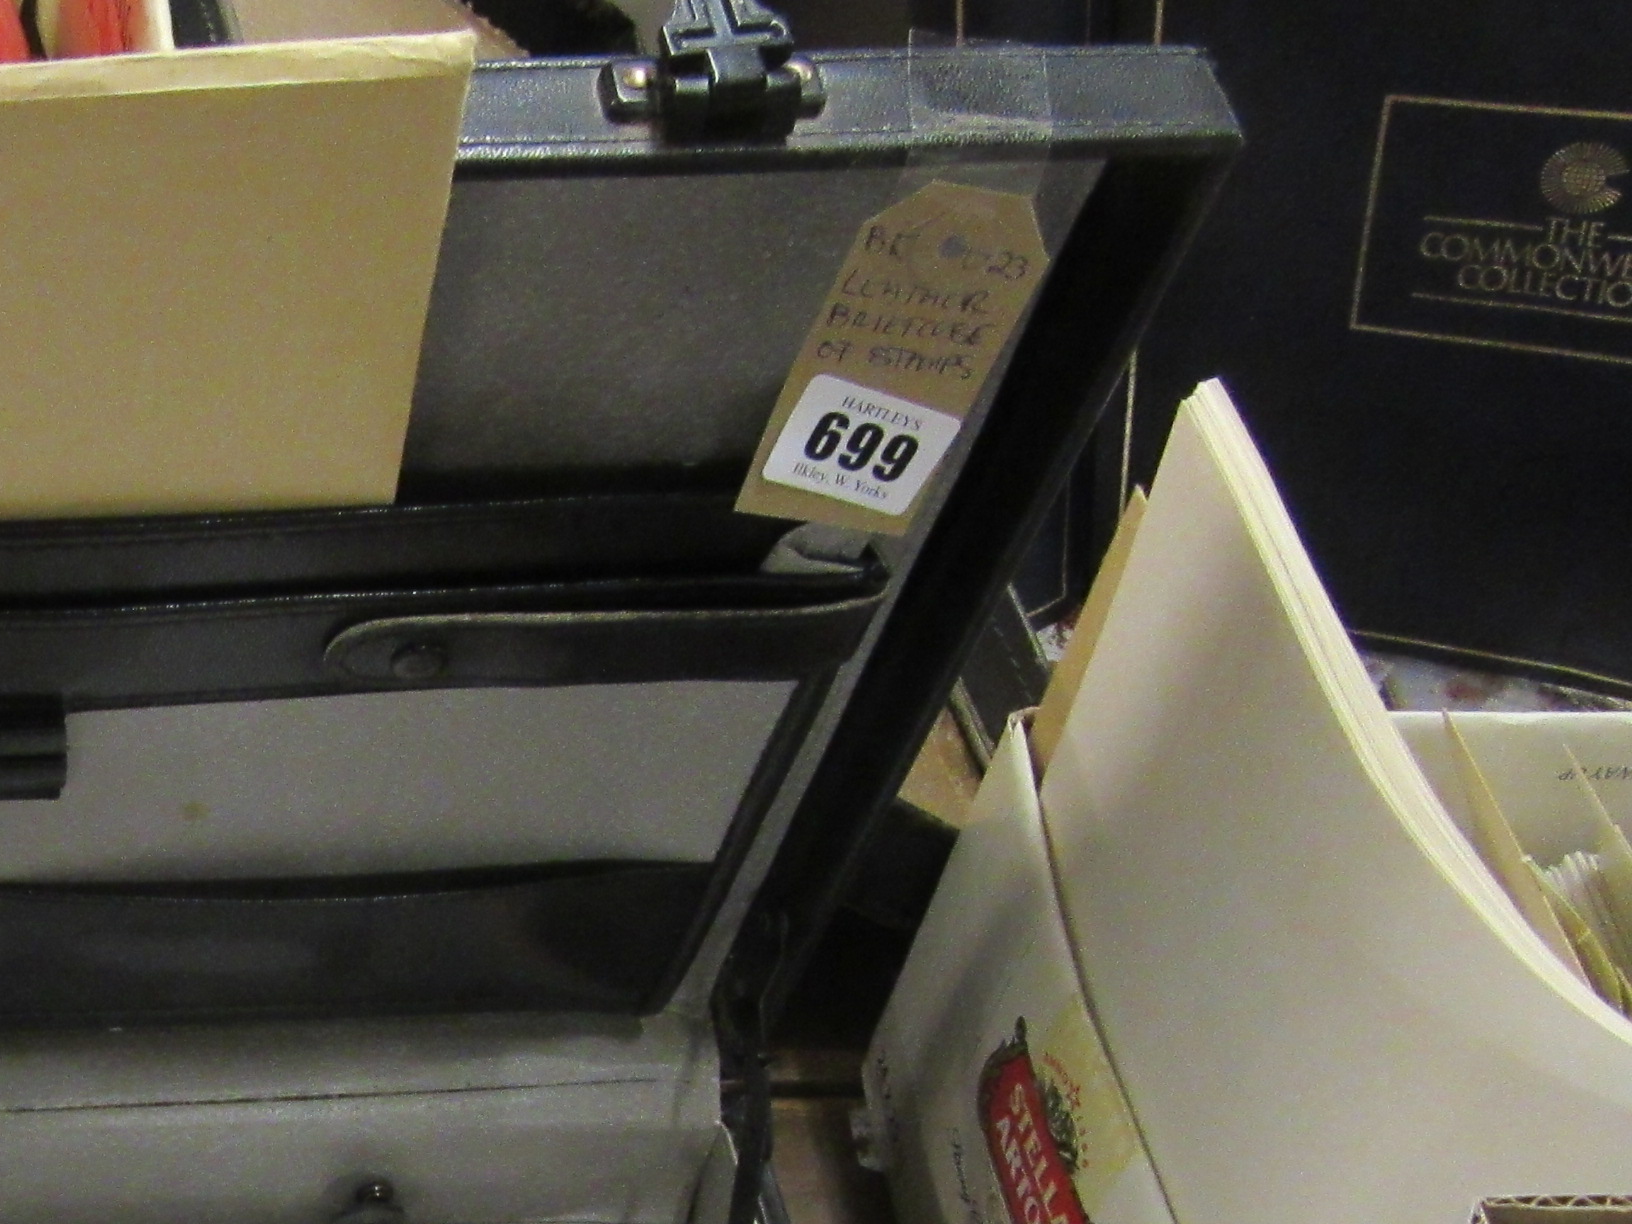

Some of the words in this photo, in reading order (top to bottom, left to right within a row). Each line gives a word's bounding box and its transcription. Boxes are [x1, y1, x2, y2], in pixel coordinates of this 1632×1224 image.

[1545, 216, 1606, 248] THE
[841, 396, 924, 432] HARTLEYS
[804, 411, 920, 482] 699
[855, 479, 890, 500] Yorks
